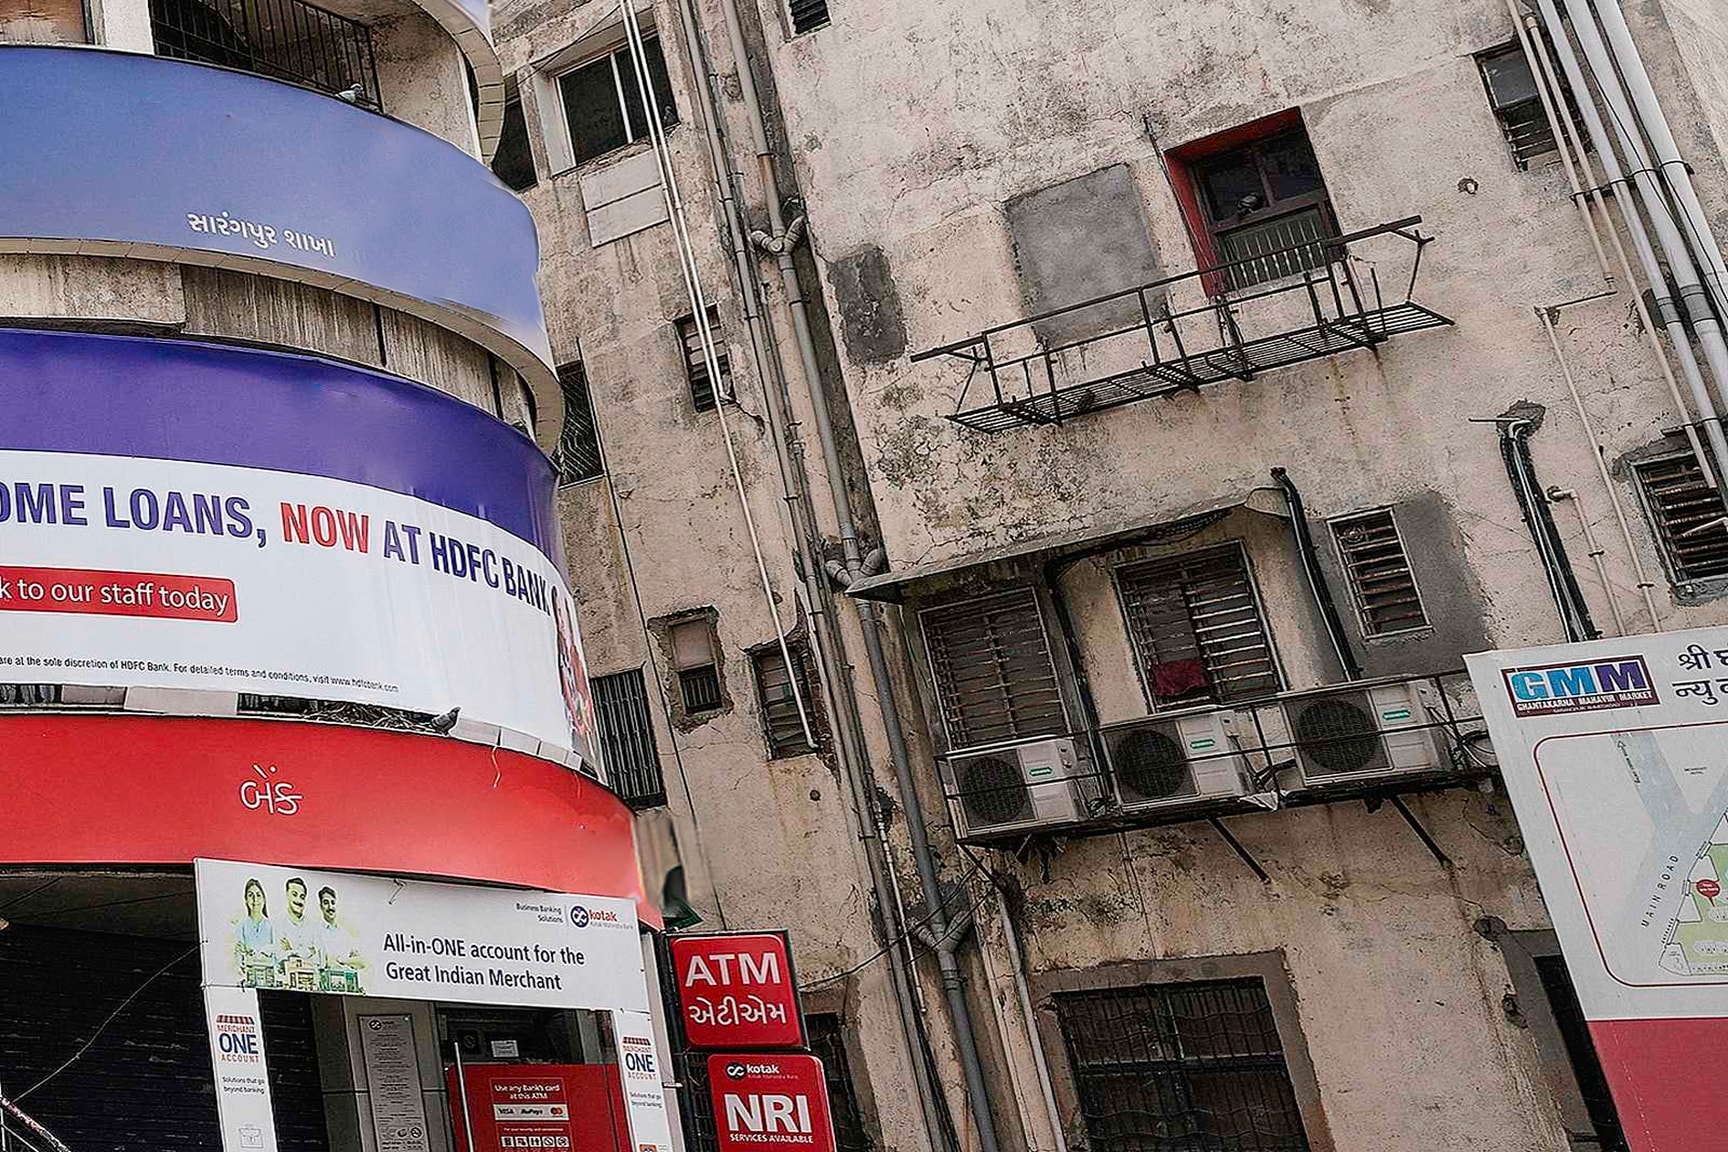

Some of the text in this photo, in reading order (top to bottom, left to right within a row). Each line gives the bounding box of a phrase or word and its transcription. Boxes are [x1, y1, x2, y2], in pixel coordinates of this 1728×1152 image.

[186, 210, 336, 258] સારંગપુર શાખા
[102, 486, 268, 548] LOANS,
[280, 502, 370, 554] NOW
[384, 519, 421, 564] AT
[429, 532, 499, 589] HDFC
[501, 556, 552, 617] BANK
[17, 578, 44, 600] to
[50, 583, 94, 603] our
[101, 578, 154, 606] staff
[160, 585, 229, 617] today
[26, 656, 41, 667] the
[43, 657, 62, 667] sole
[64, 658, 108, 669] discretion
[121, 660, 146, 671] HDFC
[173, 663, 188, 673] For
[225, 667, 250, 677] terms
[251, 668, 267, 679] and
[1677, 644, 1712, 670] श्री
[1510, 661, 1646, 701] GMM
[1618, 690, 1653, 701] MARKET
[239, 763, 304, 815] બેંક
[1641, 855, 1679, 928] MAIN ROAD
[516, 902, 562, 916] Business Banking
[537, 914, 563, 924] Solutions
[589, 909, 618, 922] kotak
[383, 933, 586, 966] All-in-ONE account for the
[385, 961, 563, 991] Great Indian Merchant
[685, 952, 781, 987] ATM
[688, 994, 787, 1026] એટીએમ
[216, 1024, 255, 1034] MERCHANT
[218, 1032, 259, 1055] ONE
[221, 1055, 260, 1063] ACCOUNT
[625, 1053, 655, 1073] ONE
[745, 1063, 780, 1074] kotak
[222, 1076, 246, 1084] Solutions
[244, 1086, 265, 1094] banking
[494, 1084, 508, 1092] Use
[498, 1107, 515, 1115] VISA
[724, 1094, 813, 1133] NRI
[730, 1133, 814, 1144] SERVICES AVAILABLE
